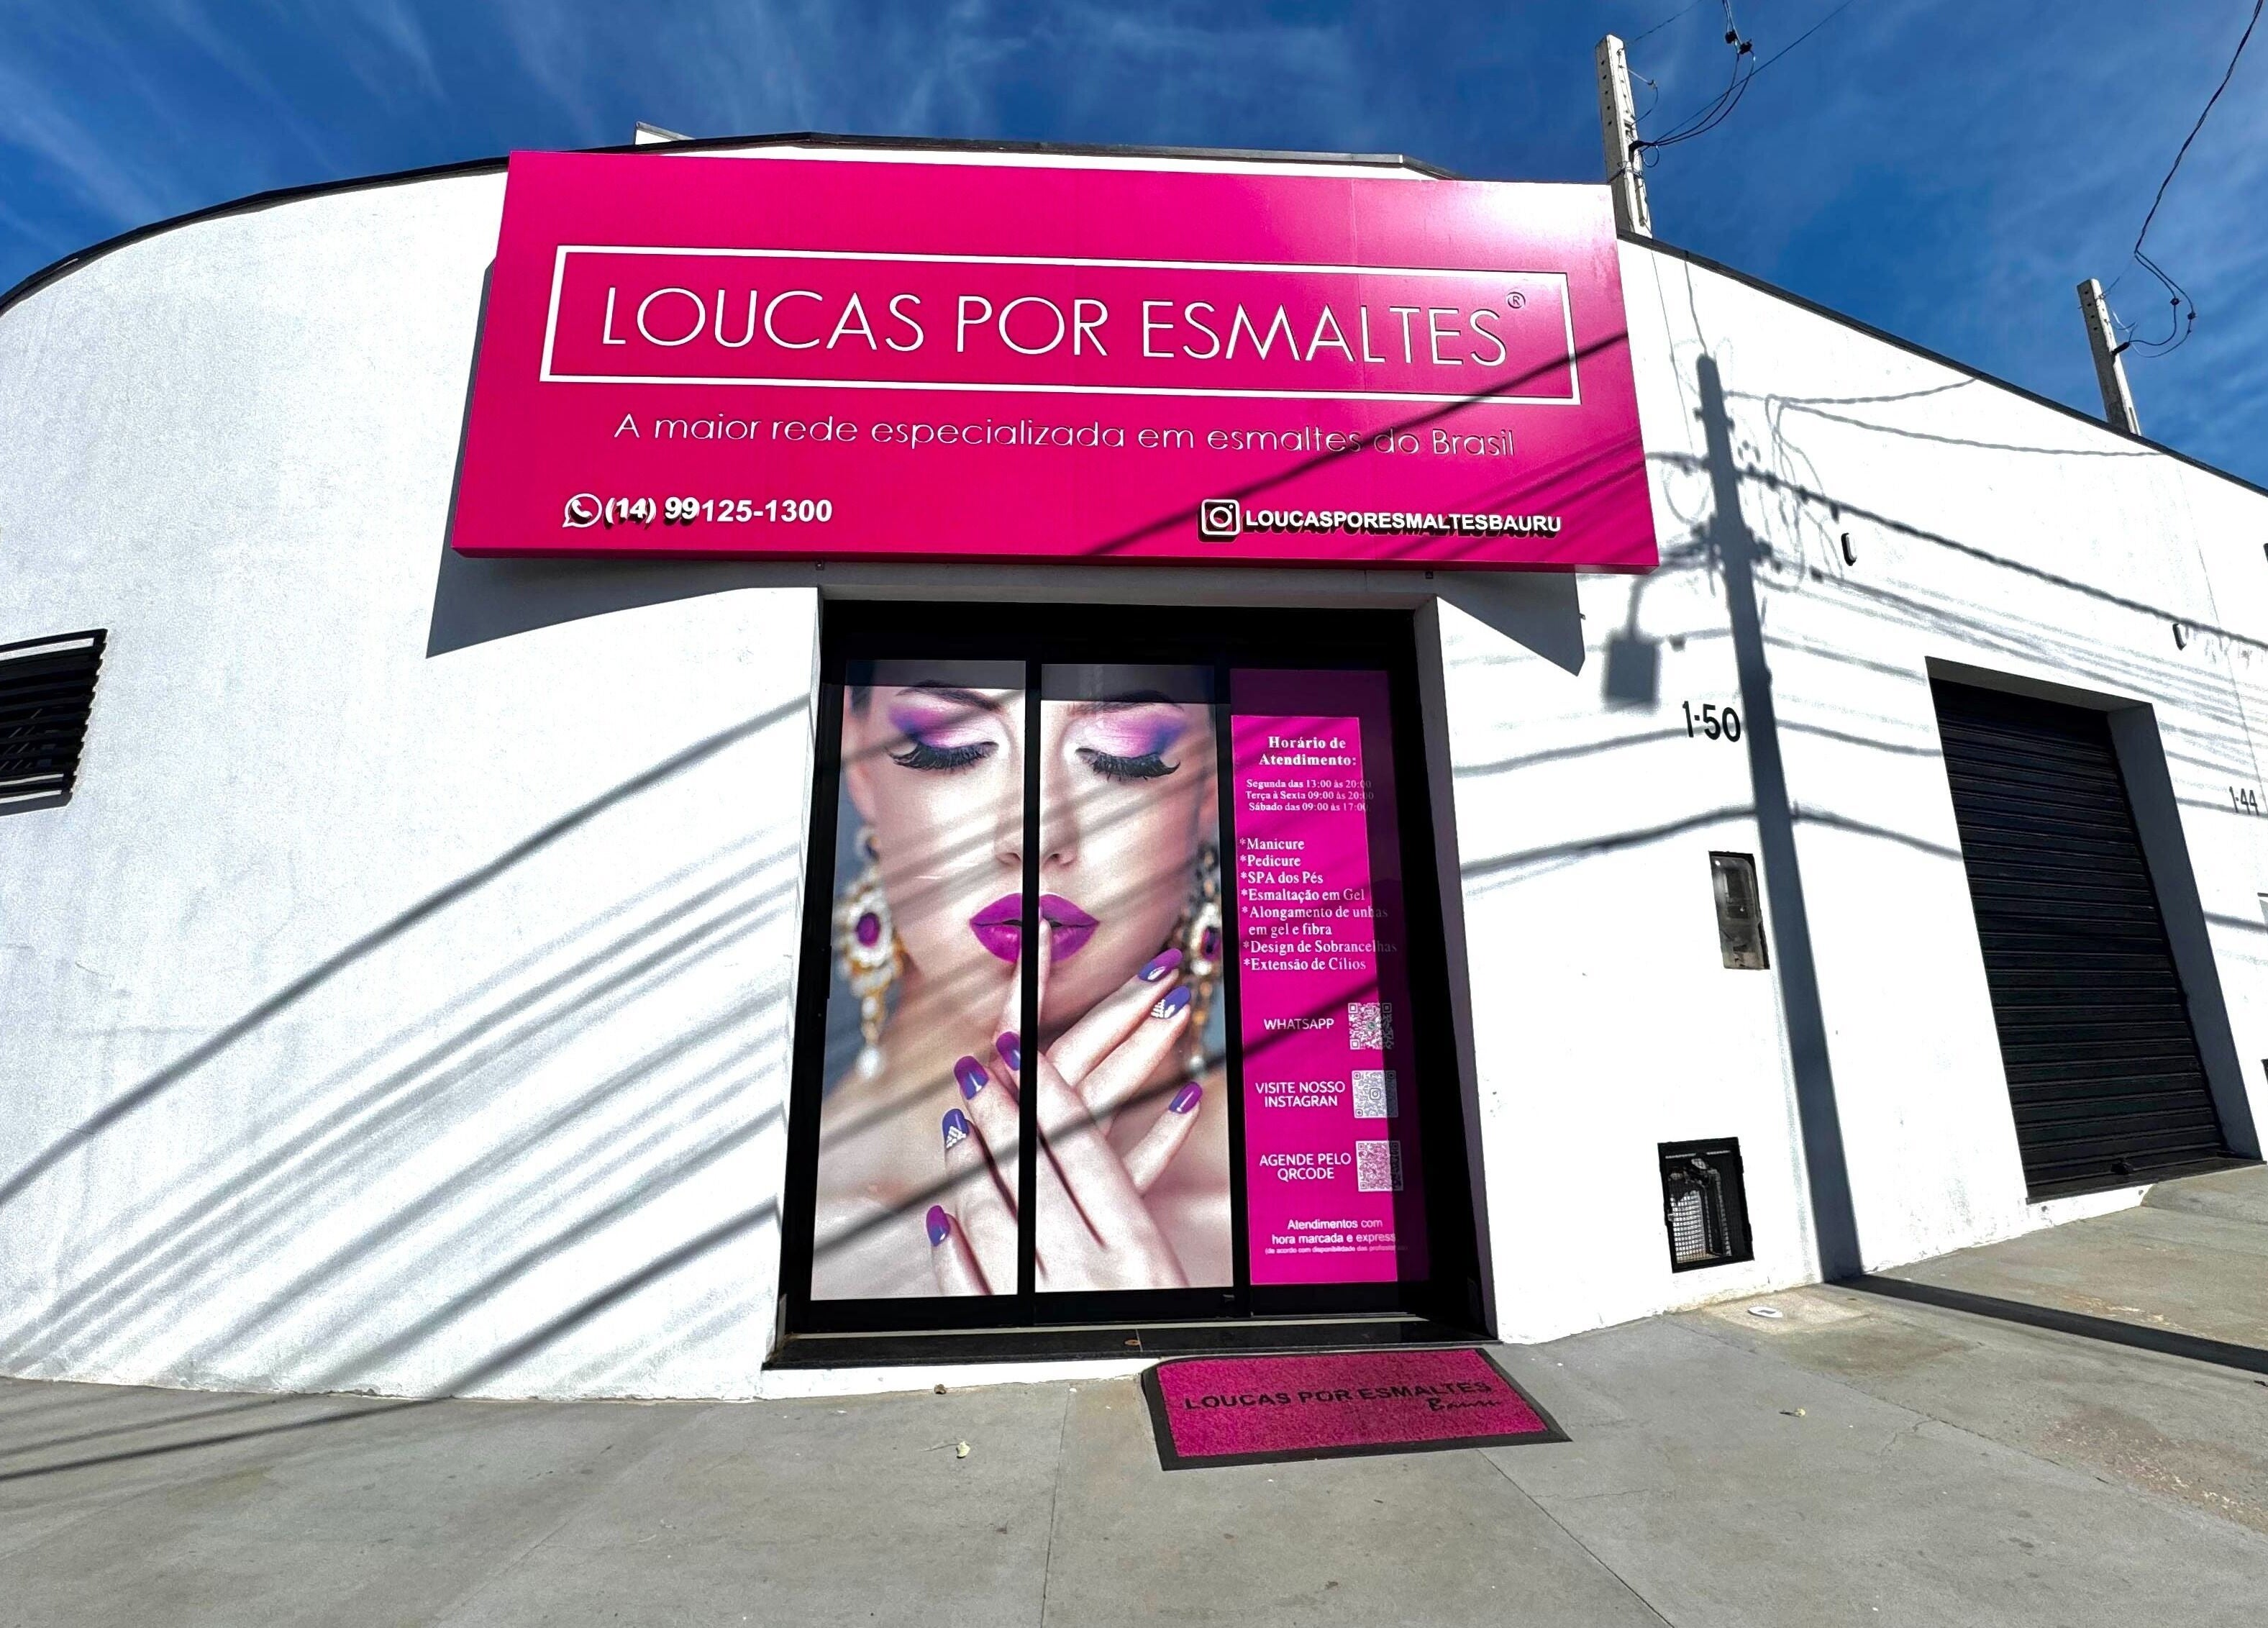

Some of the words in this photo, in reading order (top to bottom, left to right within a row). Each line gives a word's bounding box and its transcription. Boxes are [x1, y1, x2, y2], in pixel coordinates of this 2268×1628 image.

[602, 287, 924, 352] LOUCAS
[957, 296, 1108, 356] POR
[1142, 300, 1507, 367] ESMALTES
[614, 413, 640, 438] A
[655, 413, 762, 440] maior
[772, 415, 858, 442] rede
[871, 419, 1124, 450] especializada
[1138, 429, 1194, 449] em
[1207, 426, 1360, 452] esmaltes
[1374, 426, 1420, 455] do
[1432, 429, 1516, 457] Brasil
[605, 497, 657, 524] (14)
[665, 496, 832, 522] 99125-1300
[1246, 509, 1561, 532] LOUCASPORESMALTESBAURU
[1268, 736, 1326, 749] Horário
[1329, 737, 1346, 749] de
[1259, 753, 1356, 766] Atendimento:
[1246, 778, 1287, 790] Segunda
[1288, 779, 1304, 788] das
[1306, 779, 1332, 788] 13:00
[1245, 790, 1272, 801] Terça
[1280, 790, 1306, 800] Sexta
[1307, 791, 1334, 799] 09:00
[1248, 801, 1283, 811] Sábado
[1284, 802, 1301, 811] das
[1301, 802, 1329, 811] 09:00
[1278, 871, 1300, 884] dos
[1302, 870, 1324, 884] Pés
[1321, 891, 1340, 901] em
[1343, 888, 1365, 901] Gel
[1335, 905, 1349, 918] de
[1352, 905, 1388, 918] unhas
[1248, 926, 1267, 936] em
[1270, 922, 1290, 939] gel
[1292, 926, 1299, 935] e
[1302, 922, 1332, 935] fibra
[1297, 940, 1312, 953] de
[1315, 940, 1397, 952] Sobrancelhas
[1311, 957, 1326, 970] de
[1328, 957, 1366, 970] Cílios
[1263, 1017, 1334, 1030] WHATSAPP
[1254, 1081, 1295, 1094] VISITE
[1299, 1081, 1346, 1093] NOSSO
[1265, 1095, 1338, 1108] INSTAGRAN
[1259, 1153, 1314, 1167] AGENDE
[1317, 1152, 1352, 1165] PELO
[1277, 1167, 1335, 1183] QRCODE
[1287, 1219, 1359, 1230] Atendimentos
[1360, 1219, 1383, 1229] com
[1271, 1234, 1296, 1245] hora
[1298, 1232, 1344, 1244] marcada
[1346, 1234, 1354, 1243] e
[1185, 1393, 1291, 1410] LOUCAS
[1300, 1390, 1352, 1402] POR
[1360, 1382, 1492, 1400] ESMALTES
